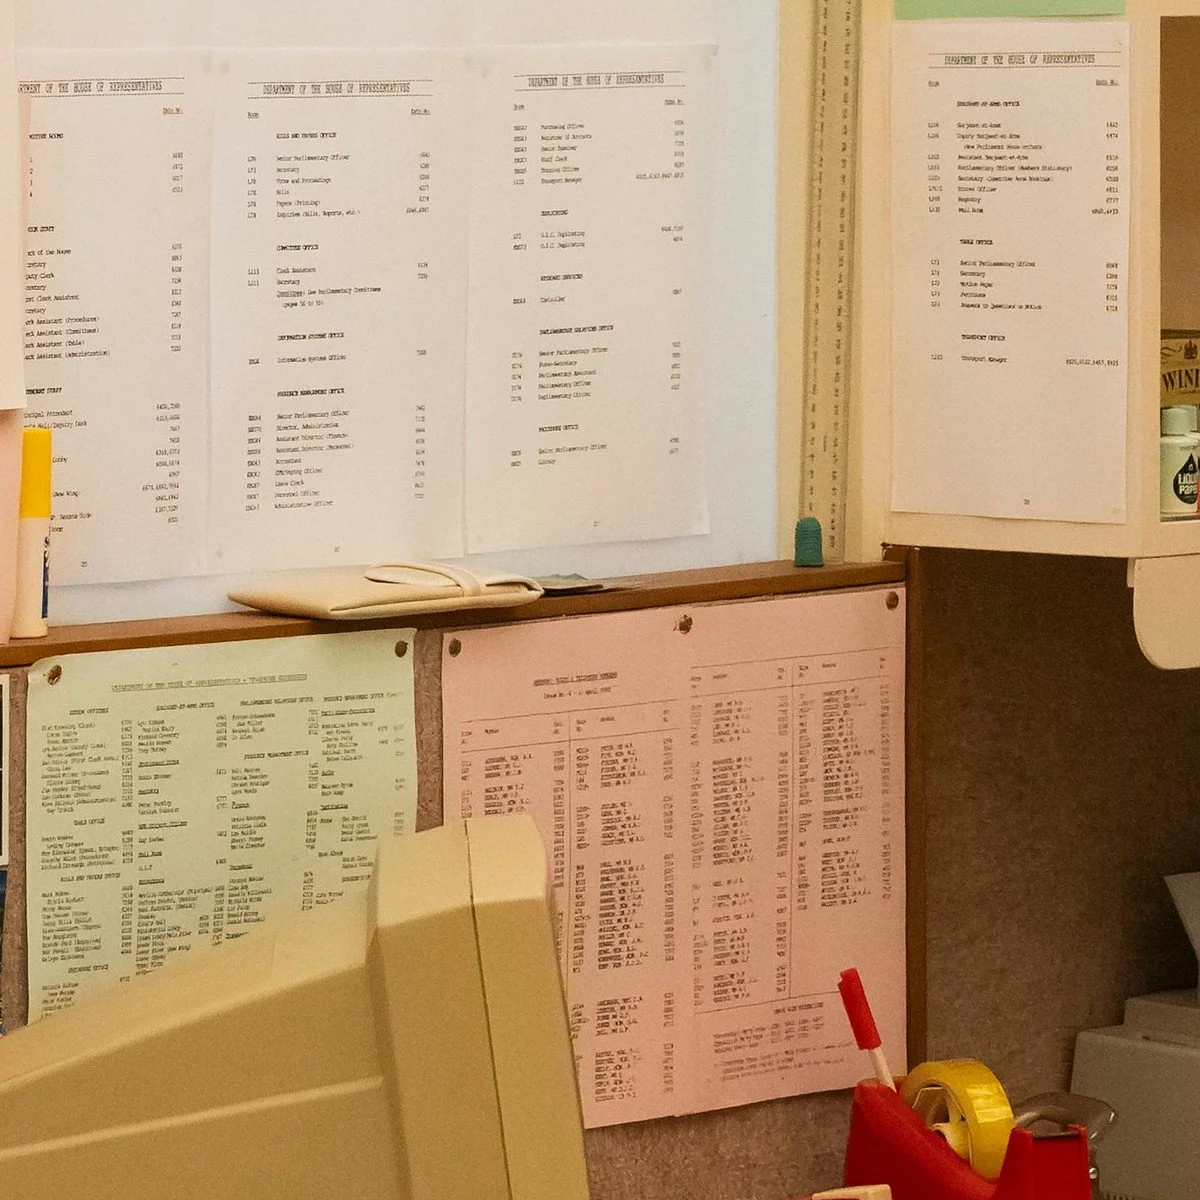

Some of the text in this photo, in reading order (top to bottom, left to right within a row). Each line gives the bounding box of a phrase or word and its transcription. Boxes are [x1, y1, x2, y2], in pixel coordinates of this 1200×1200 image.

[980, 54, 988, 65] OF
[1030, 54, 1039, 64] OF
[1043, 54, 1095, 64] REPRESENTATIVES
